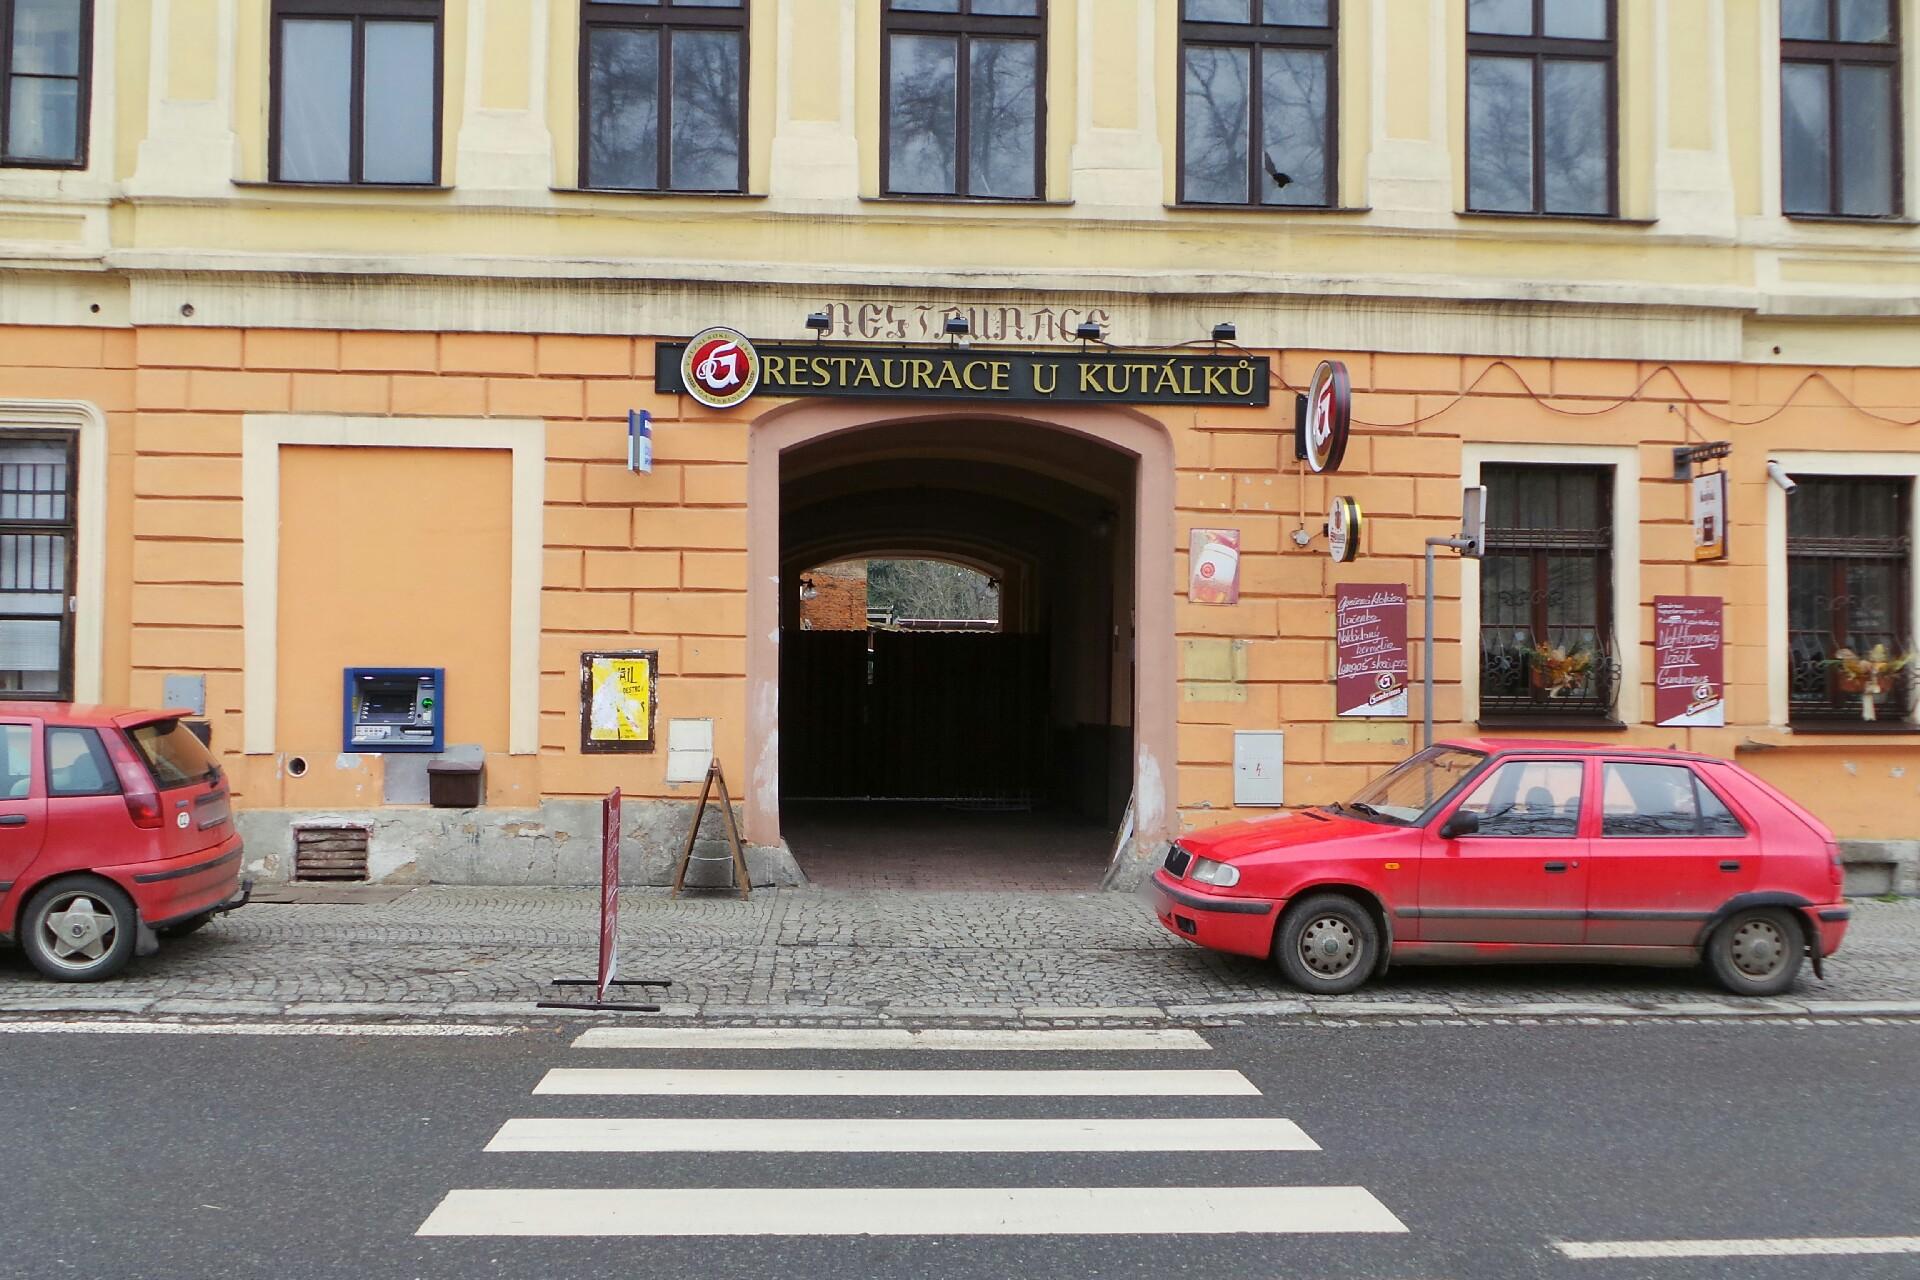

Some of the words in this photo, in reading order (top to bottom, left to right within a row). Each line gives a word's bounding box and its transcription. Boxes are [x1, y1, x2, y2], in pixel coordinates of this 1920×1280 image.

[761, 355, 1011, 391] RESTAURACE
[1032, 363, 1059, 394] U
[1078, 358, 1256, 396] KUTÁLKŮ
